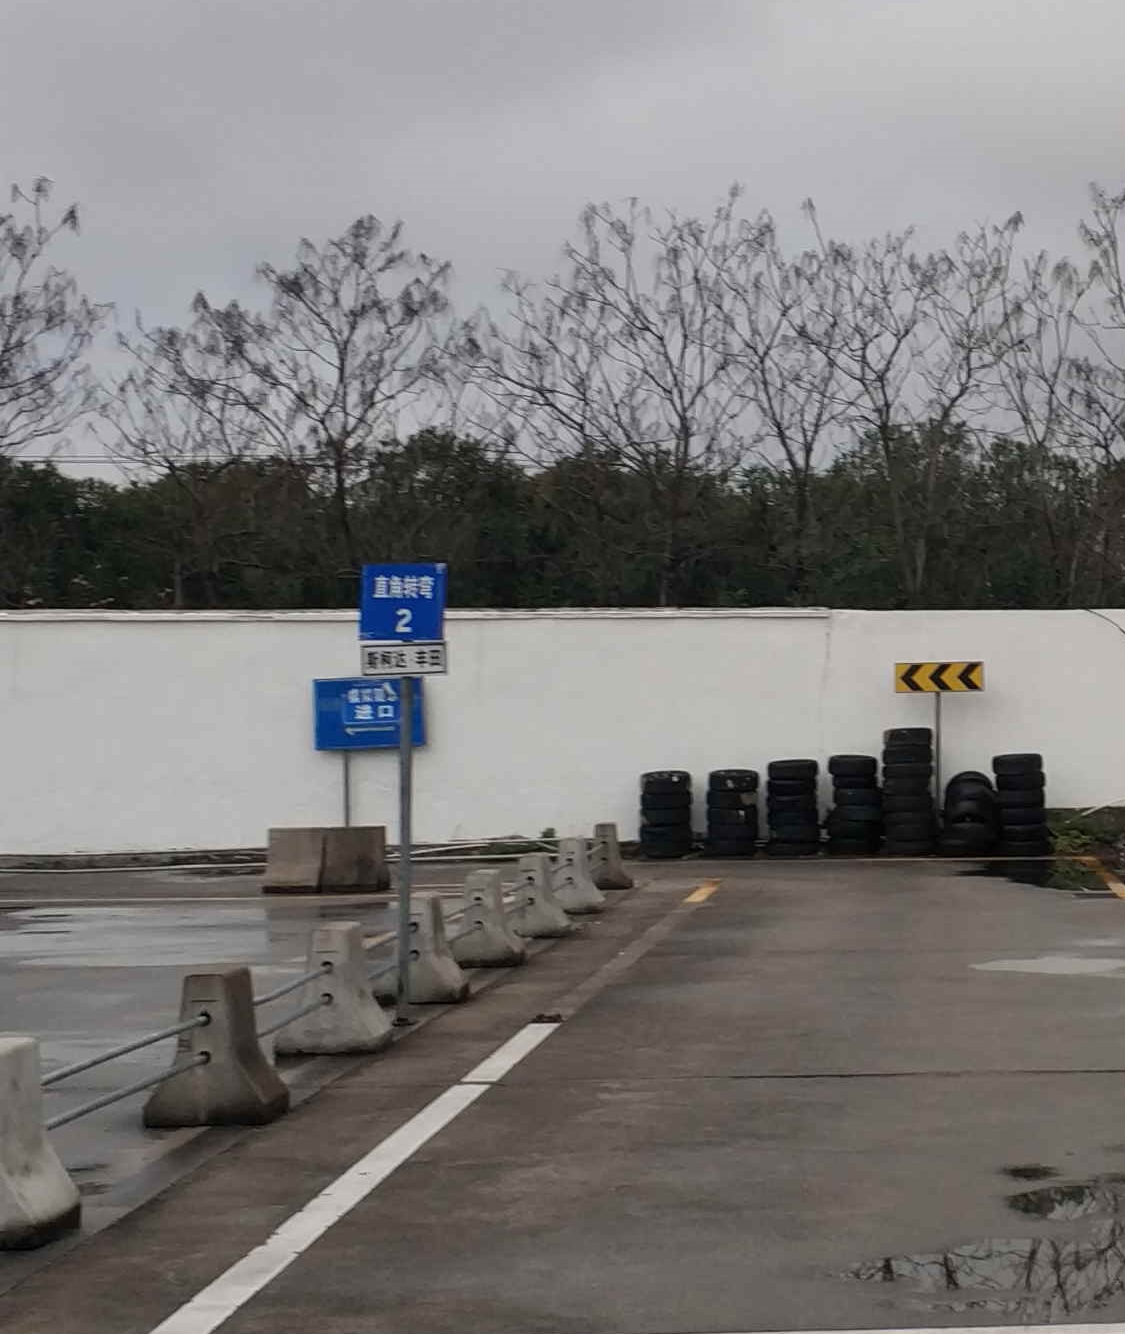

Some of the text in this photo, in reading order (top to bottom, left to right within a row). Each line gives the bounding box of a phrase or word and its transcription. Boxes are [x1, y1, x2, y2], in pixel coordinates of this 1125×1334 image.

[373, 575, 435, 599] 直角转弯
[395, 608, 413, 633] 2
